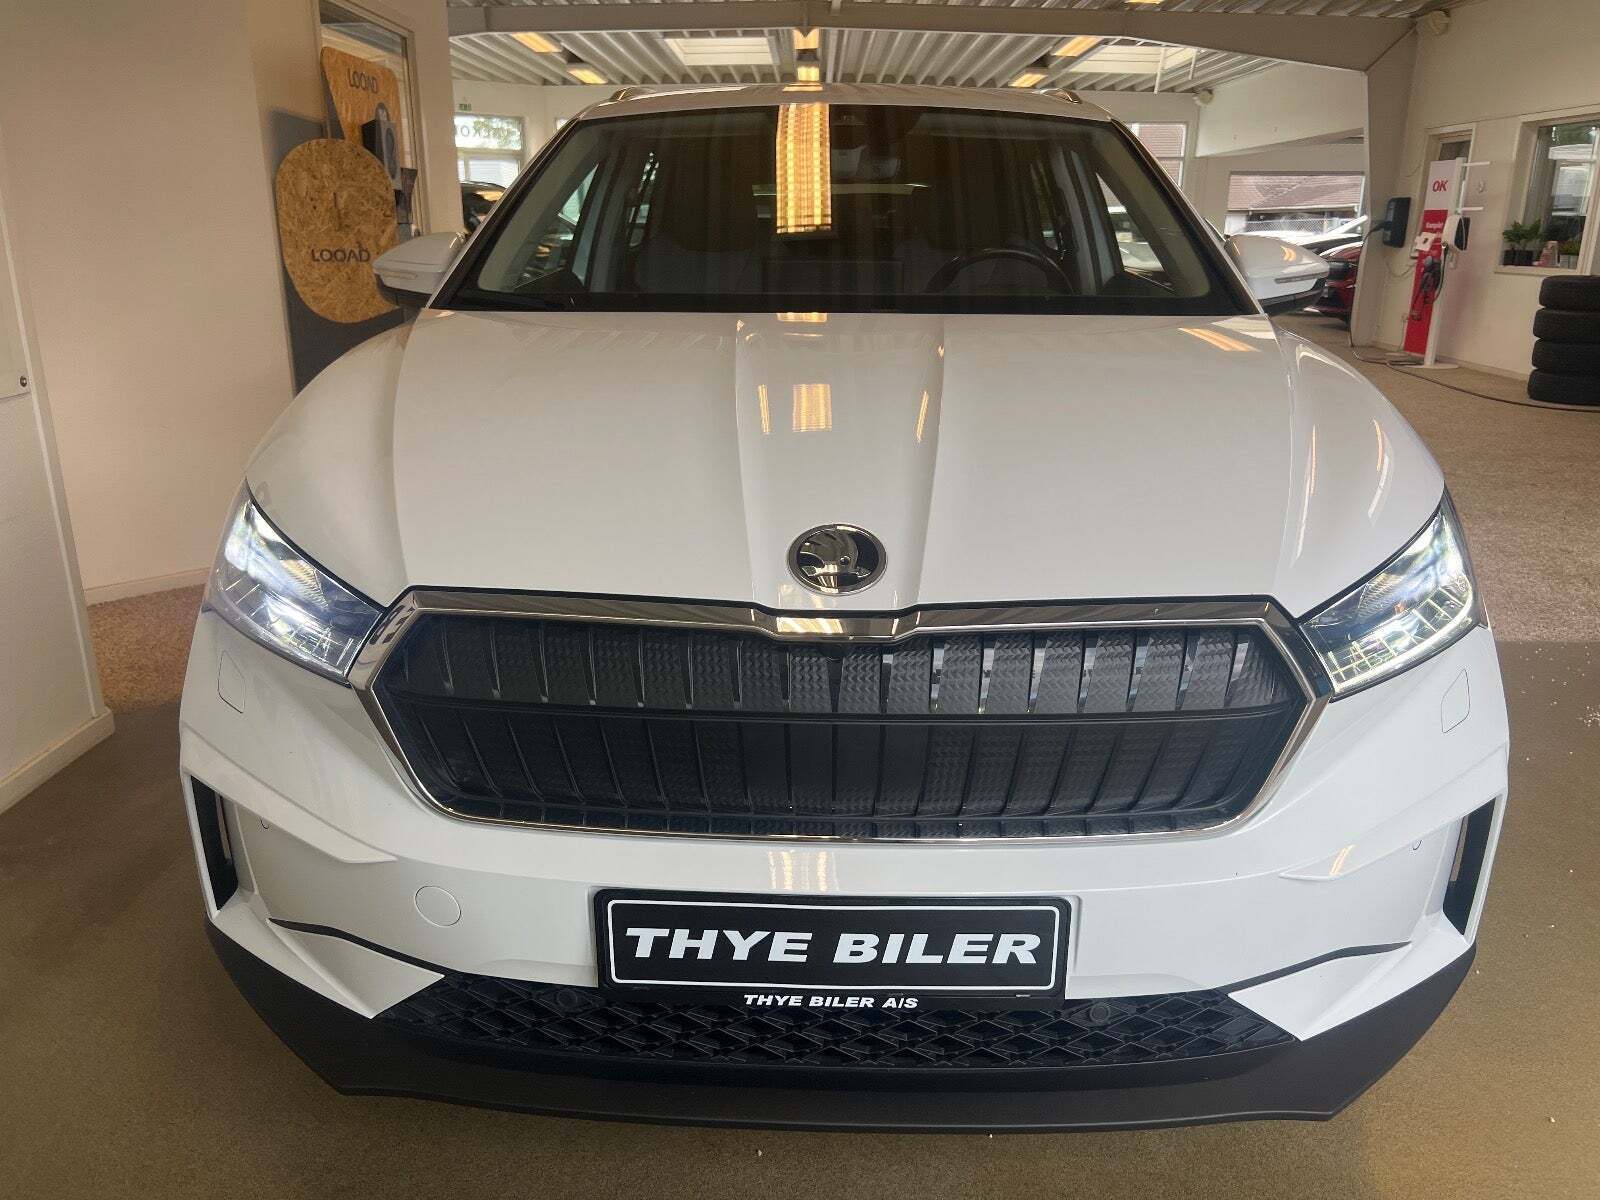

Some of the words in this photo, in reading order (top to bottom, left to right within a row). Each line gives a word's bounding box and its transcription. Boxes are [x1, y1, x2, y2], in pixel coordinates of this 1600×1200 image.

[1432, 180, 1448, 192] OK
[311, 249, 370, 262] LOOAD
[626, 928, 812, 962] THYE
[833, 934, 1040, 964] BILER
[744, 995, 803, 1006] THYE
[809, 996, 874, 1007] BILER
[882, 997, 918, 1008] A/S
